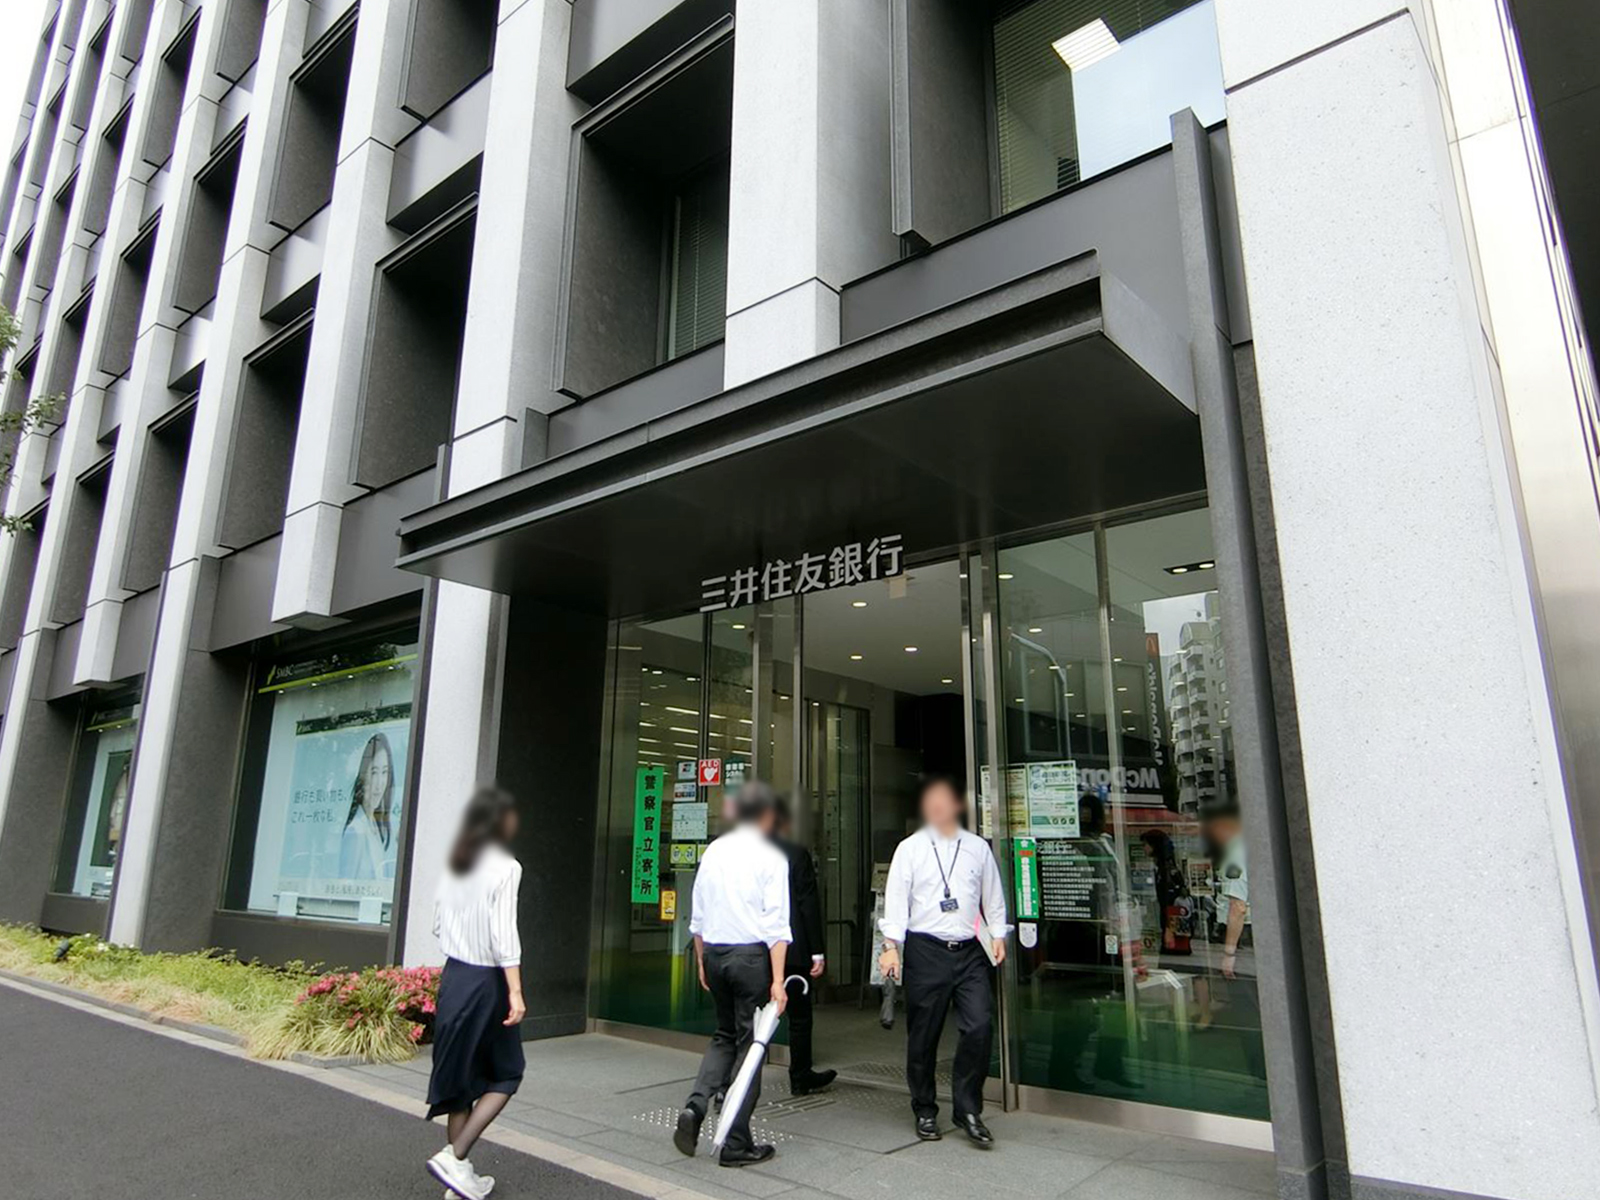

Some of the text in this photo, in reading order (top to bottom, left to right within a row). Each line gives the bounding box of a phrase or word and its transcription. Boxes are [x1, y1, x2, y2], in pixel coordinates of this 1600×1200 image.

[699, 533, 904, 613] 三井住友銀行
[701, 759, 719, 768] AED
[641, 775, 656, 895] 警察官立寄所
